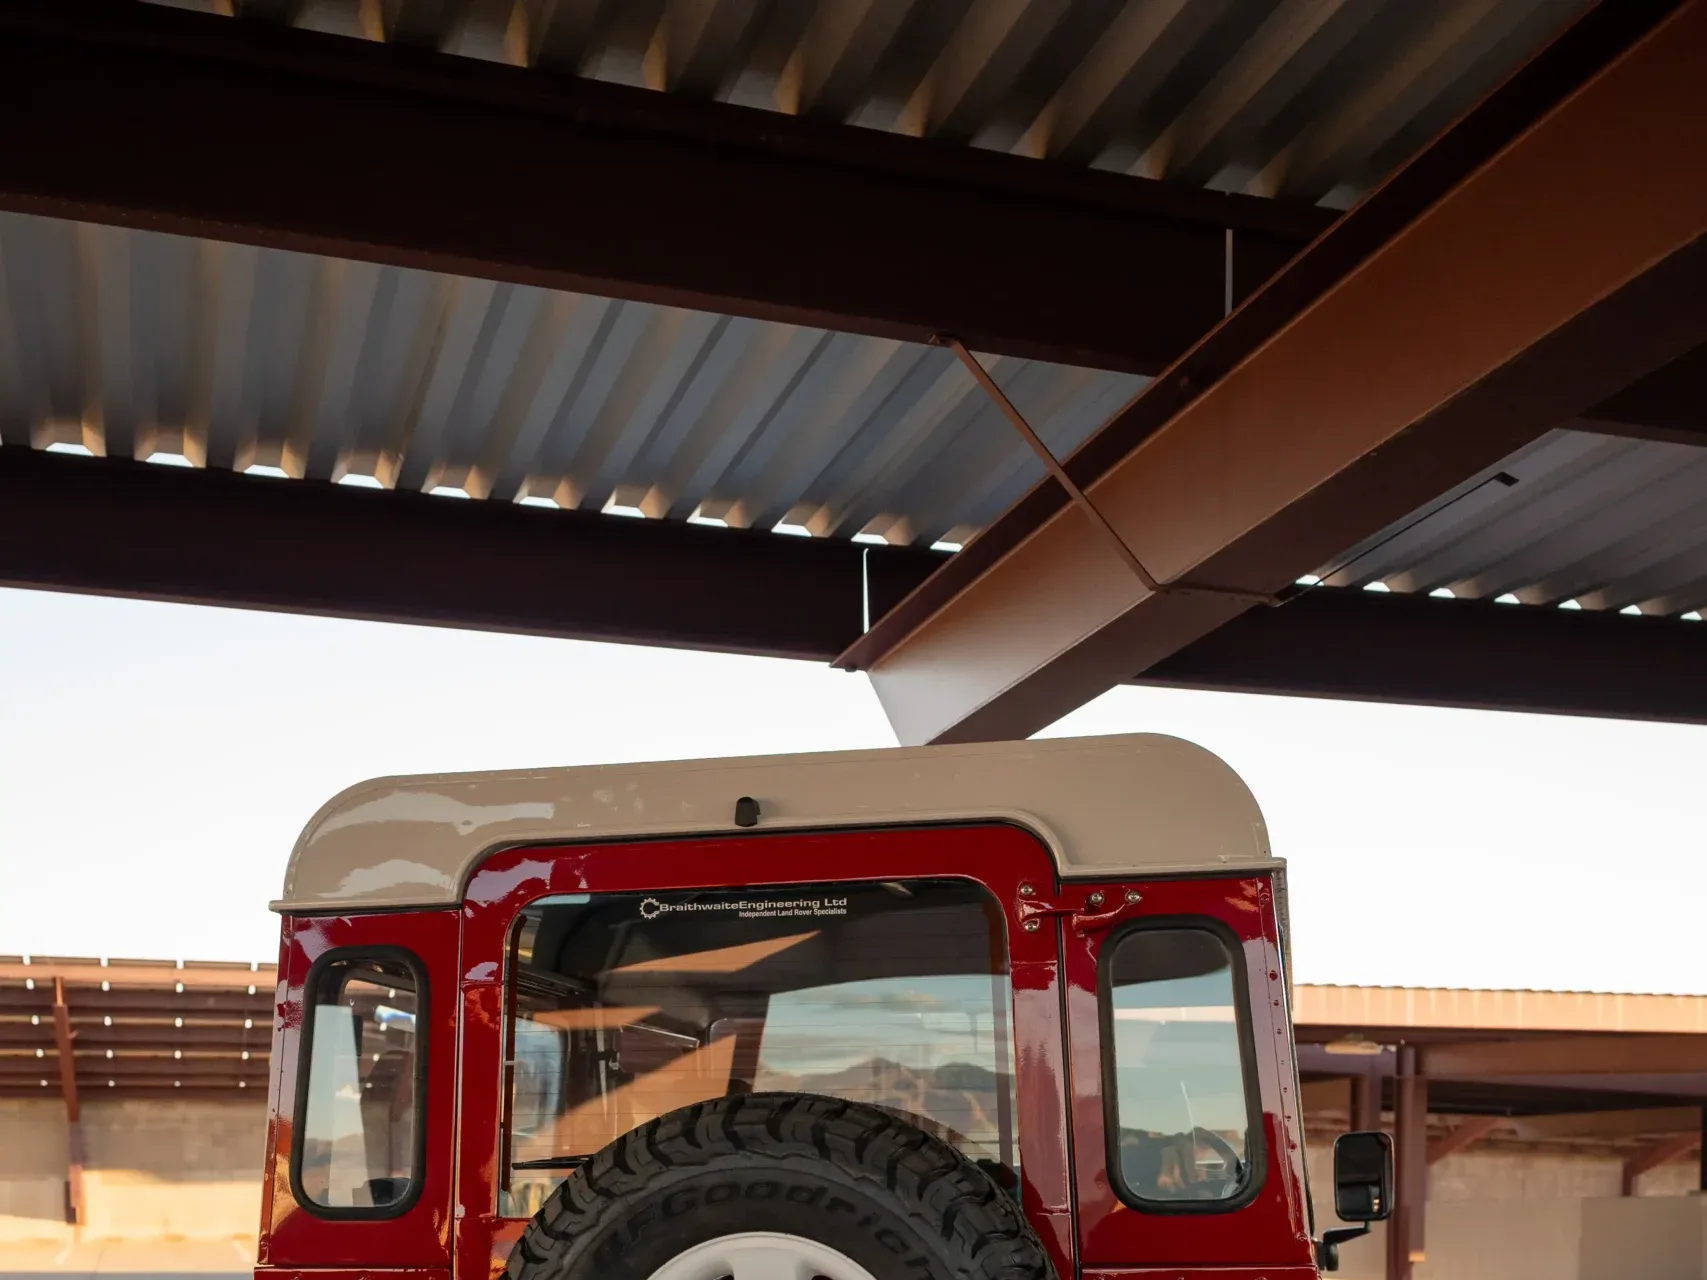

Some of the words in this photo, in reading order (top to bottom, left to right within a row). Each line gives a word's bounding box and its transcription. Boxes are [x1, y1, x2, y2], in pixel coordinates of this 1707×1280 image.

[824, 898, 847, 907] Ltd
[739, 909, 776, 918] Independent
[794, 908, 812, 916] Rover
[813, 907, 847, 916] Specialists
